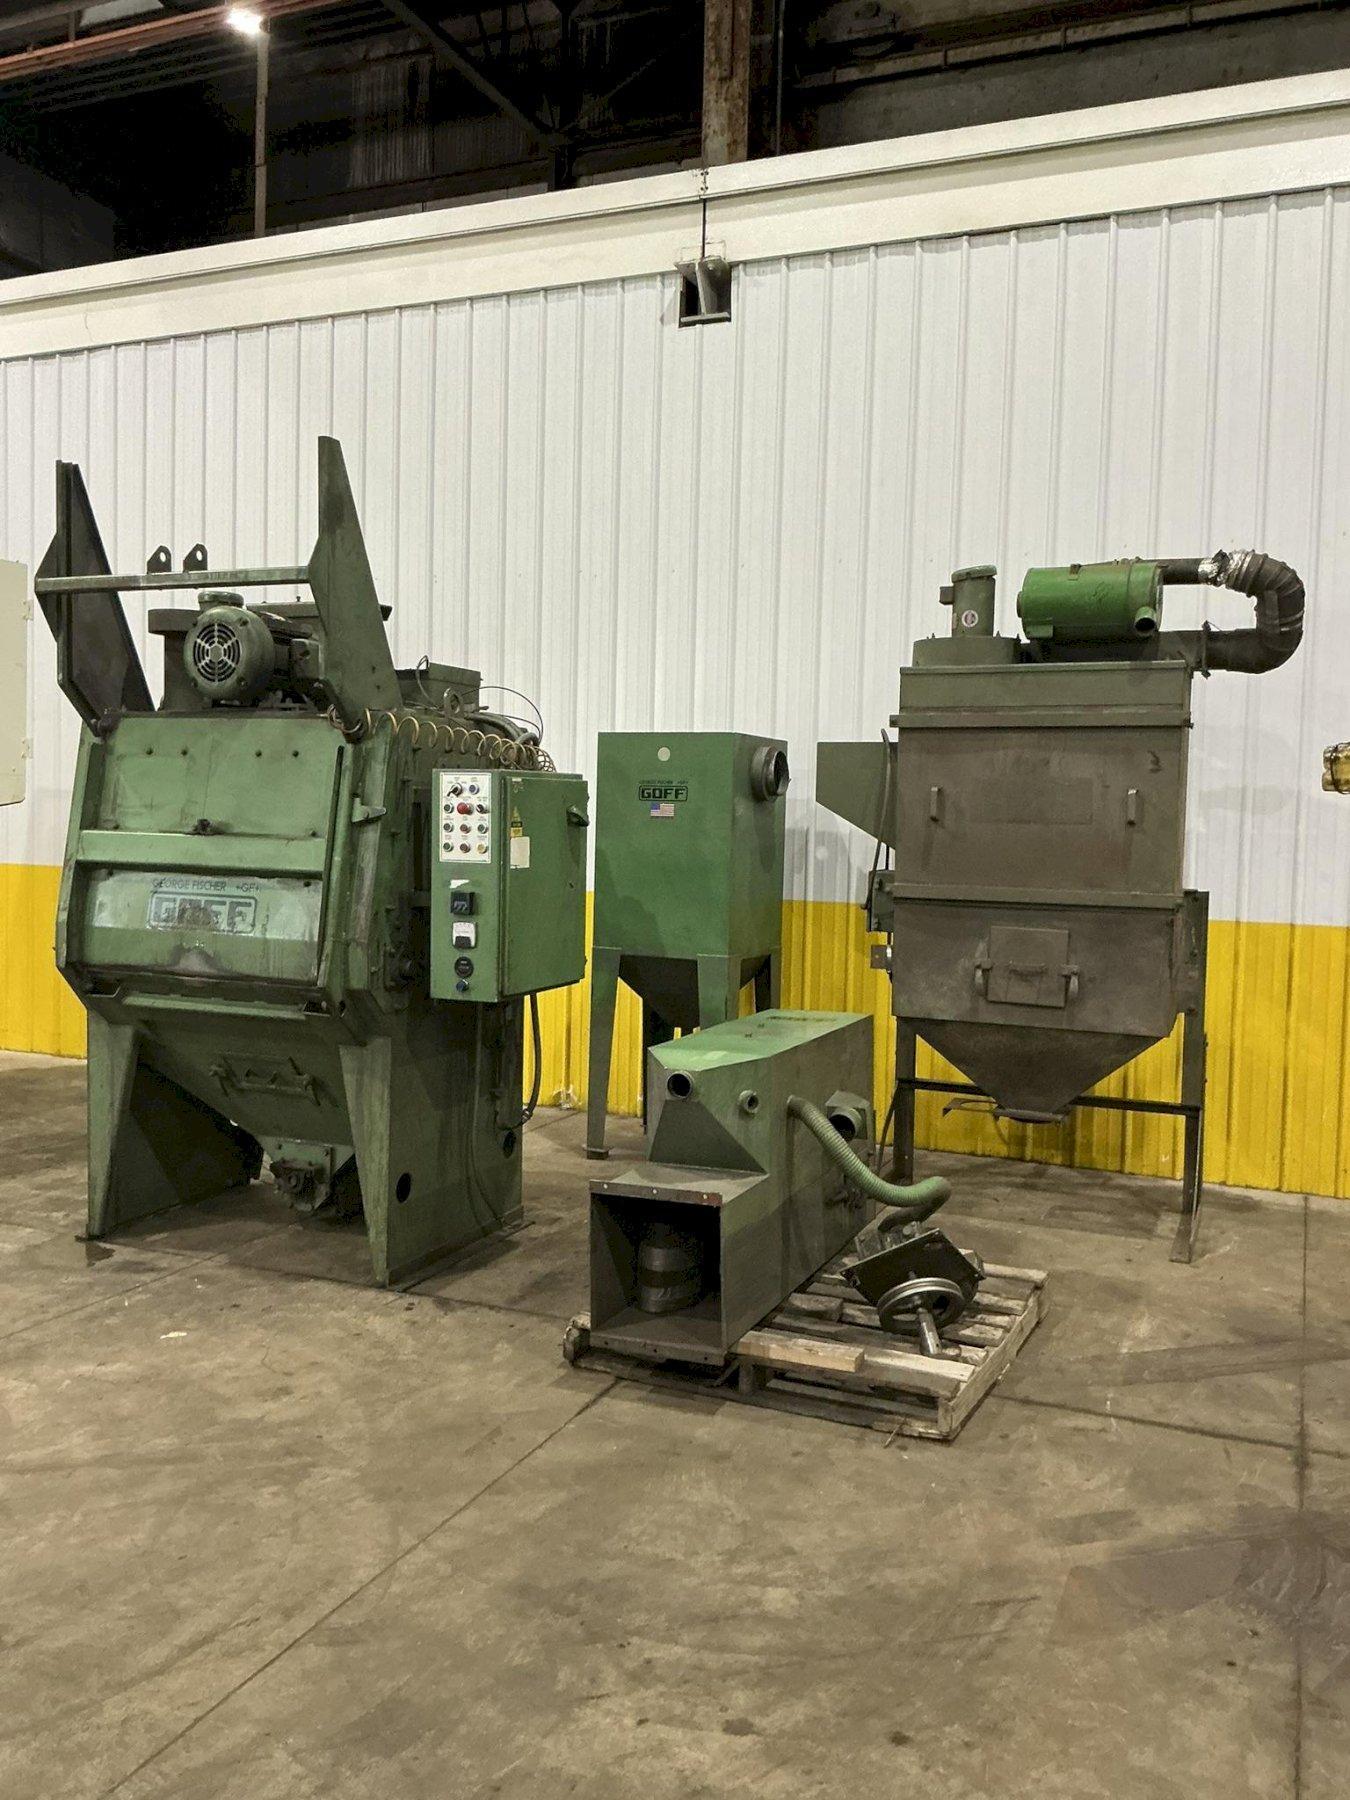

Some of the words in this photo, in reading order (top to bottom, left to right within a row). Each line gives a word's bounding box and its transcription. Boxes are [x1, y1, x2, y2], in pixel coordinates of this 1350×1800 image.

[641, 787, 686, 799] GOFF
[152, 878, 190, 889] GEORGE
[192, 879, 226, 891] FISCHER
